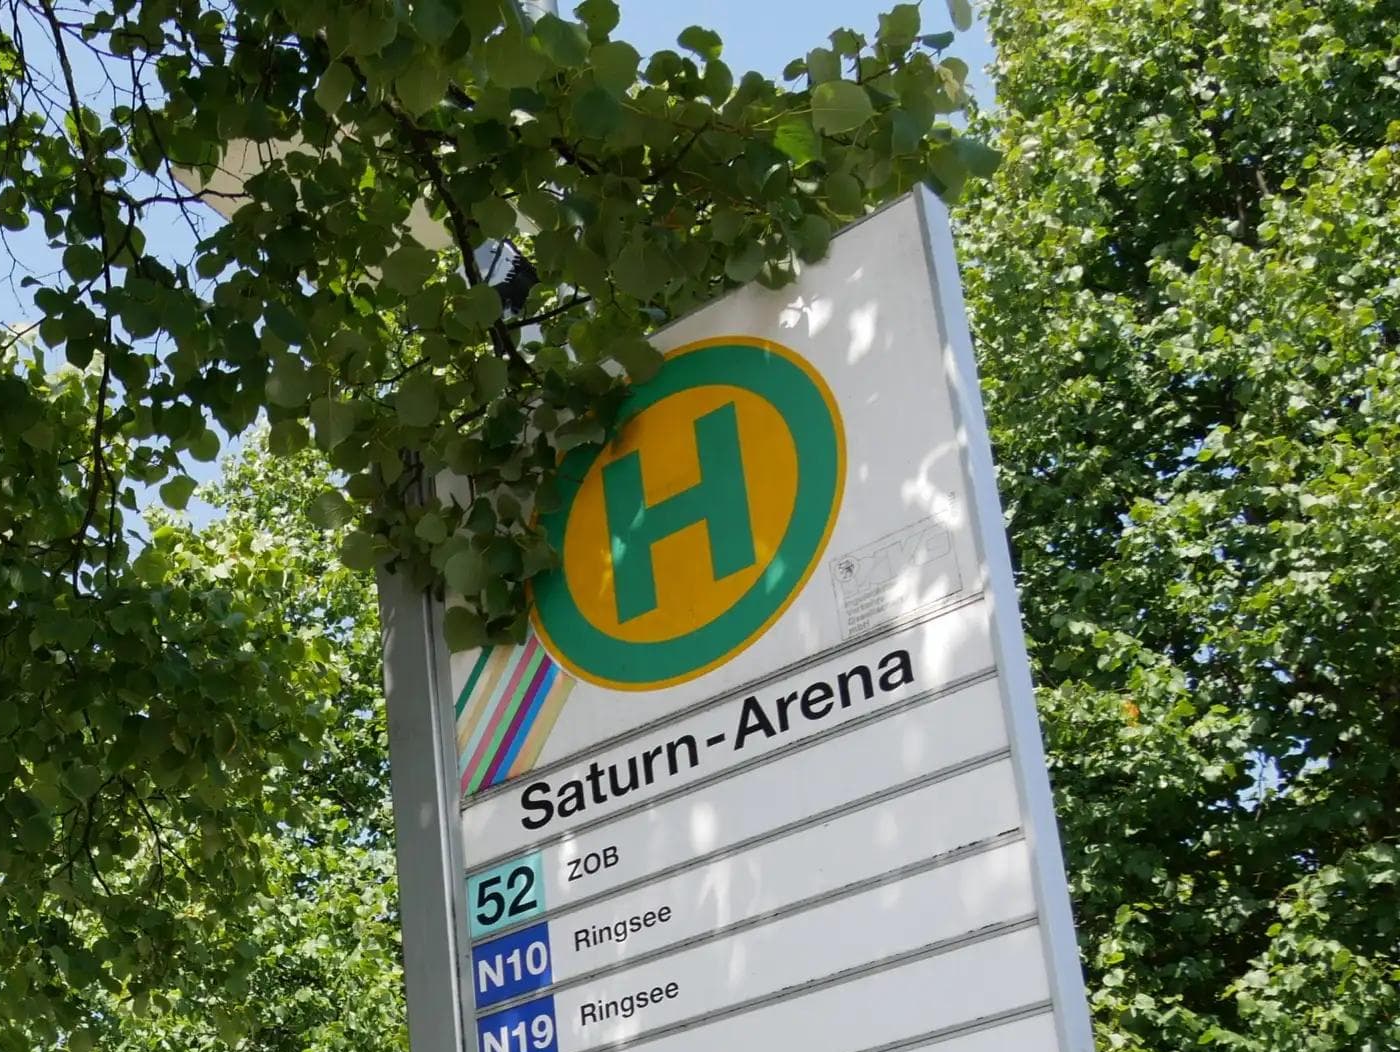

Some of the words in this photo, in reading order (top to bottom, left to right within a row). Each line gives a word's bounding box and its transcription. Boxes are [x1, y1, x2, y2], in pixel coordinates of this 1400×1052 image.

[602, 401, 756, 625] H
[521, 649, 914, 830] Saturn-Arena
[476, 866, 537, 925] 52
[567, 846, 619, 881] ZOB
[478, 941, 548, 992] N10
[574, 905, 672, 951] Ringsee
[580, 982, 679, 1026] Ringsee
